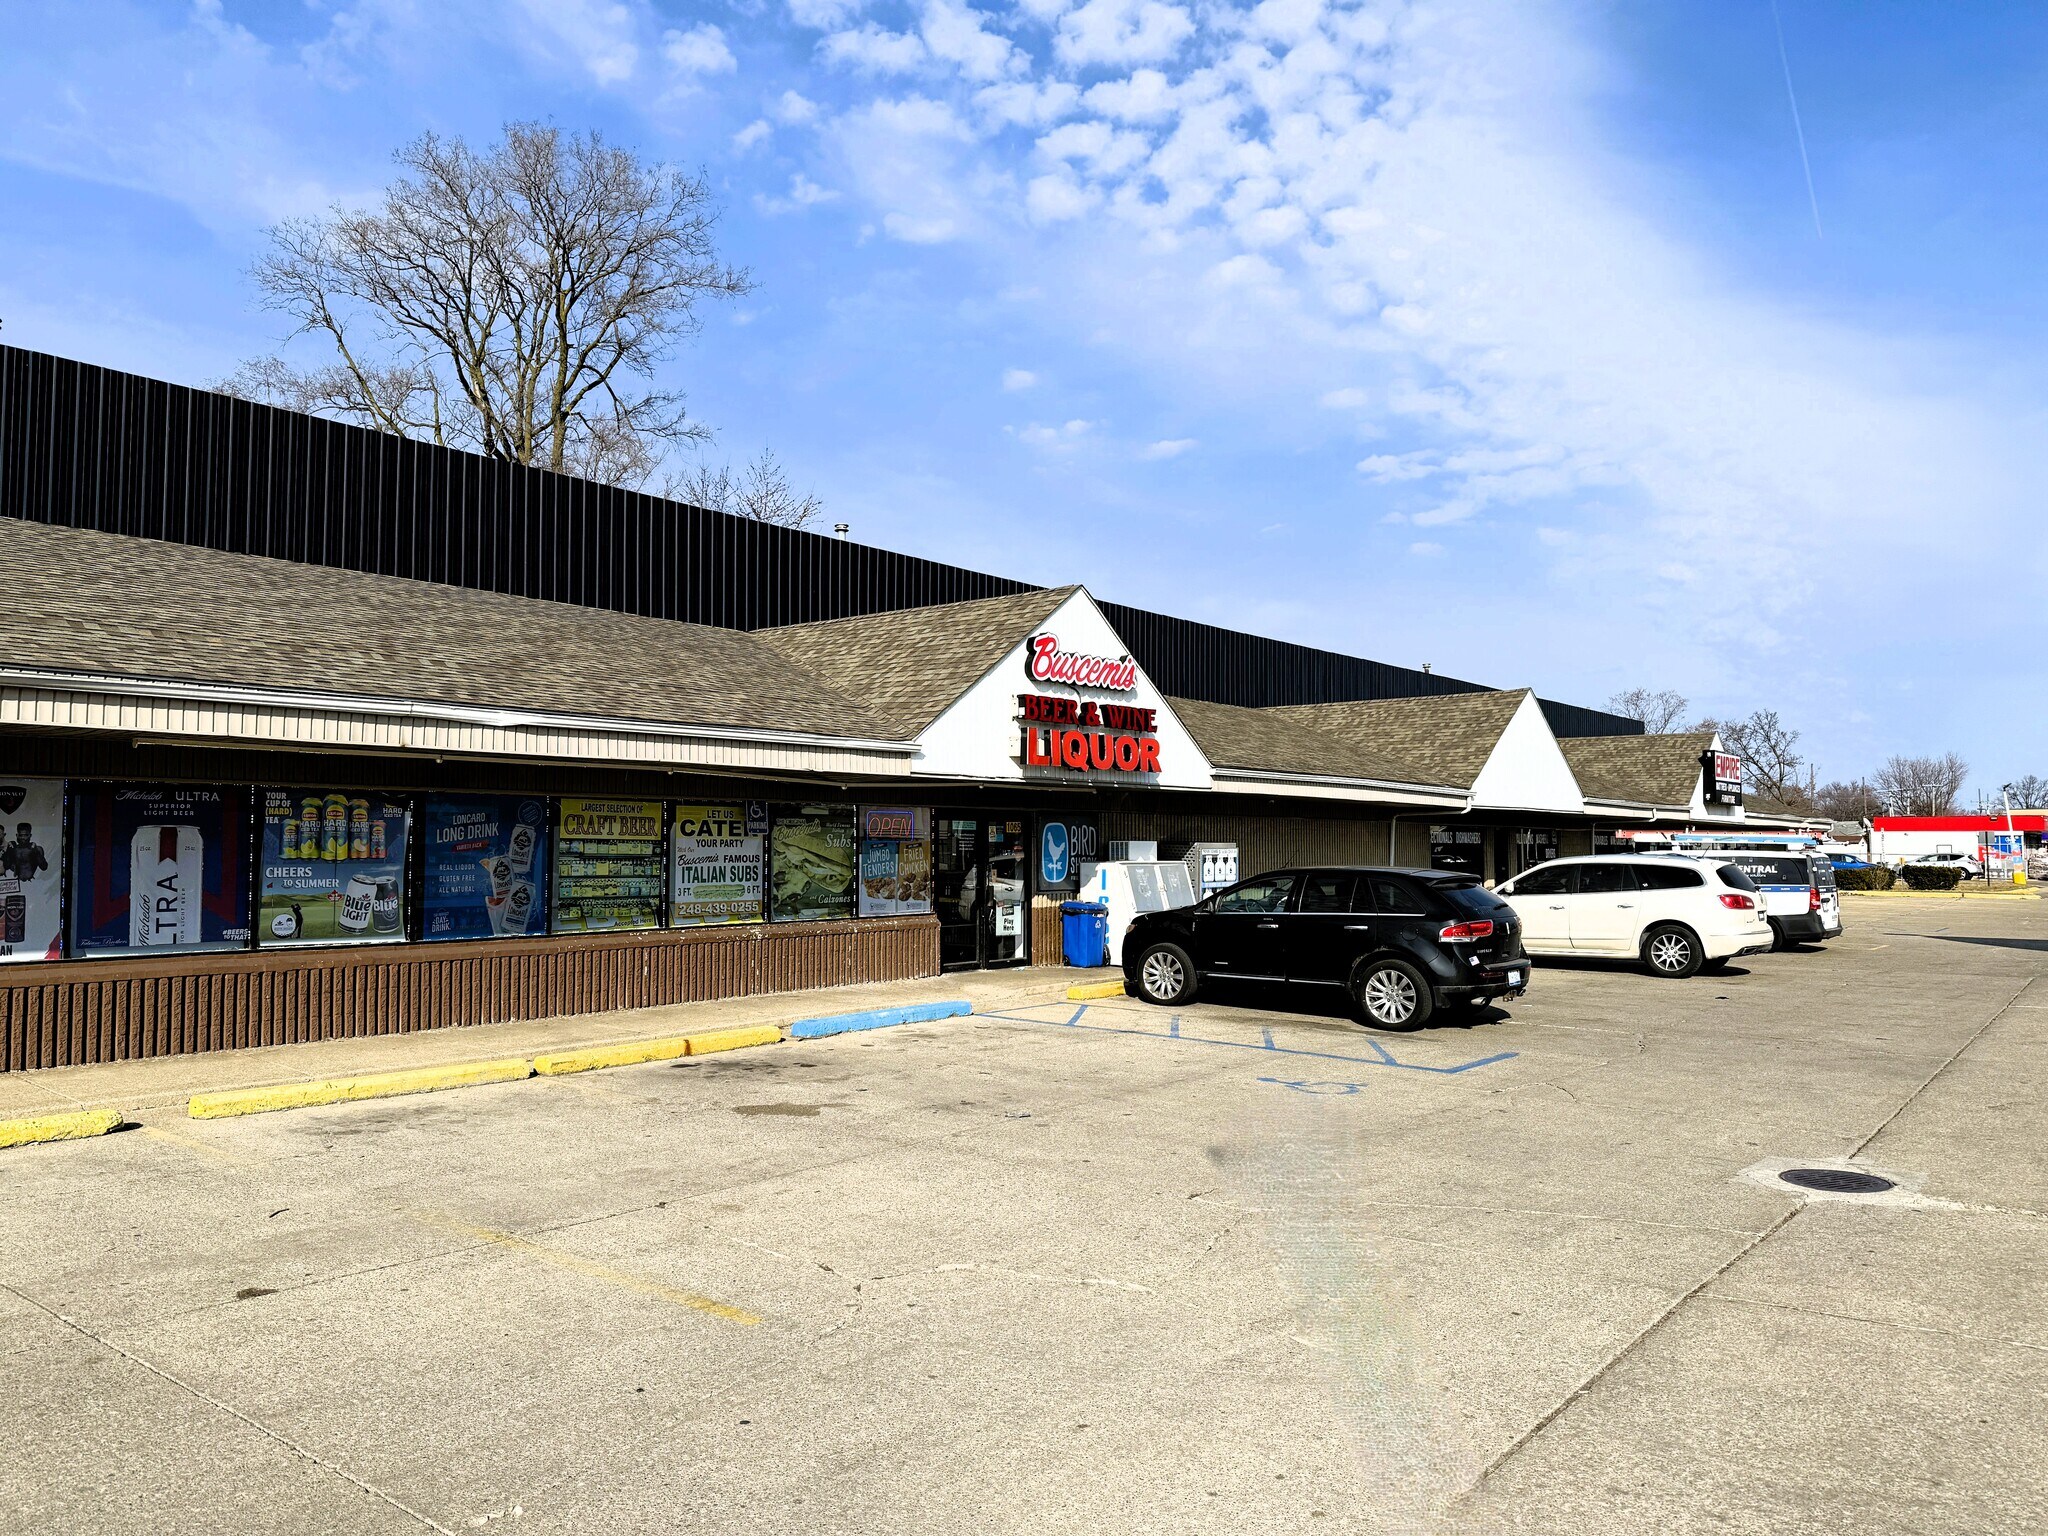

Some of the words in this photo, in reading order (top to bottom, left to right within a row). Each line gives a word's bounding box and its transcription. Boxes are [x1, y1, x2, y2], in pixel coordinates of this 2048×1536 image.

[1024, 694, 1078, 725] BEER
[1086, 701, 1101, 727] &
[1106, 704, 1158, 733] WINE
[1027, 726, 1162, 773] LIQUOR
[1716, 755, 1740, 780] EMPIRE
[115, 790, 162, 800] Michelob
[175, 791, 220, 802] ULTRA
[266, 792, 287, 800] YOUR
[265, 800, 281, 808] CUP
[282, 800, 292, 808] OF
[582, 803, 606, 812] LARGEST
[606, 804, 636, 814] SELECTION
[636, 805, 644, 814] OF
[265, 807, 293, 816] (HARD)
[706, 810, 721, 818] LET
[724, 810, 734, 818] US
[452, 812, 486, 825] LONCARO
[564, 814, 616, 835] CRAFT
[618, 816, 658, 836] BEER
[868, 818, 912, 837] OPEN
[436, 826, 465, 844] LONG
[467, 822, 500, 840] DRINK
[1430, 832, 1453, 844] ECTIONALS
[696, 839, 718, 848] YOUR
[720, 840, 744, 848] PARTY
[825, 834, 852, 848] Subs
[1070, 825, 1097, 856] BIRD
[724, 854, 760, 864] FAMOUS
[868, 849, 890, 864] JUMBO
[904, 848, 924, 860] FRIED
[266, 866, 312, 878] CHEERS
[863, 861, 894, 877] TENDERS
[900, 860, 928, 876] CHICKEN
[1738, 866, 1778, 874] ENTRAL
[682, 866, 726, 884] ITALIAN
[730, 865, 758, 882] SUBS
[294, 878, 340, 888] SUMMER
[678, 888, 682, 896] 3
[683, 888, 692, 896] FT.
[746, 886, 751, 894] 6
[752, 886, 760, 894] FT.
[345, 894, 371, 912] Blue
[818, 894, 851, 904] Calzones
[373, 900, 398, 912] Blue
[678, 902, 759, 915] 248-439-0255
[138, 894, 151, 946] Michelob
[342, 908, 369, 922] LIGHT
[436, 916, 446, 924] DAY
